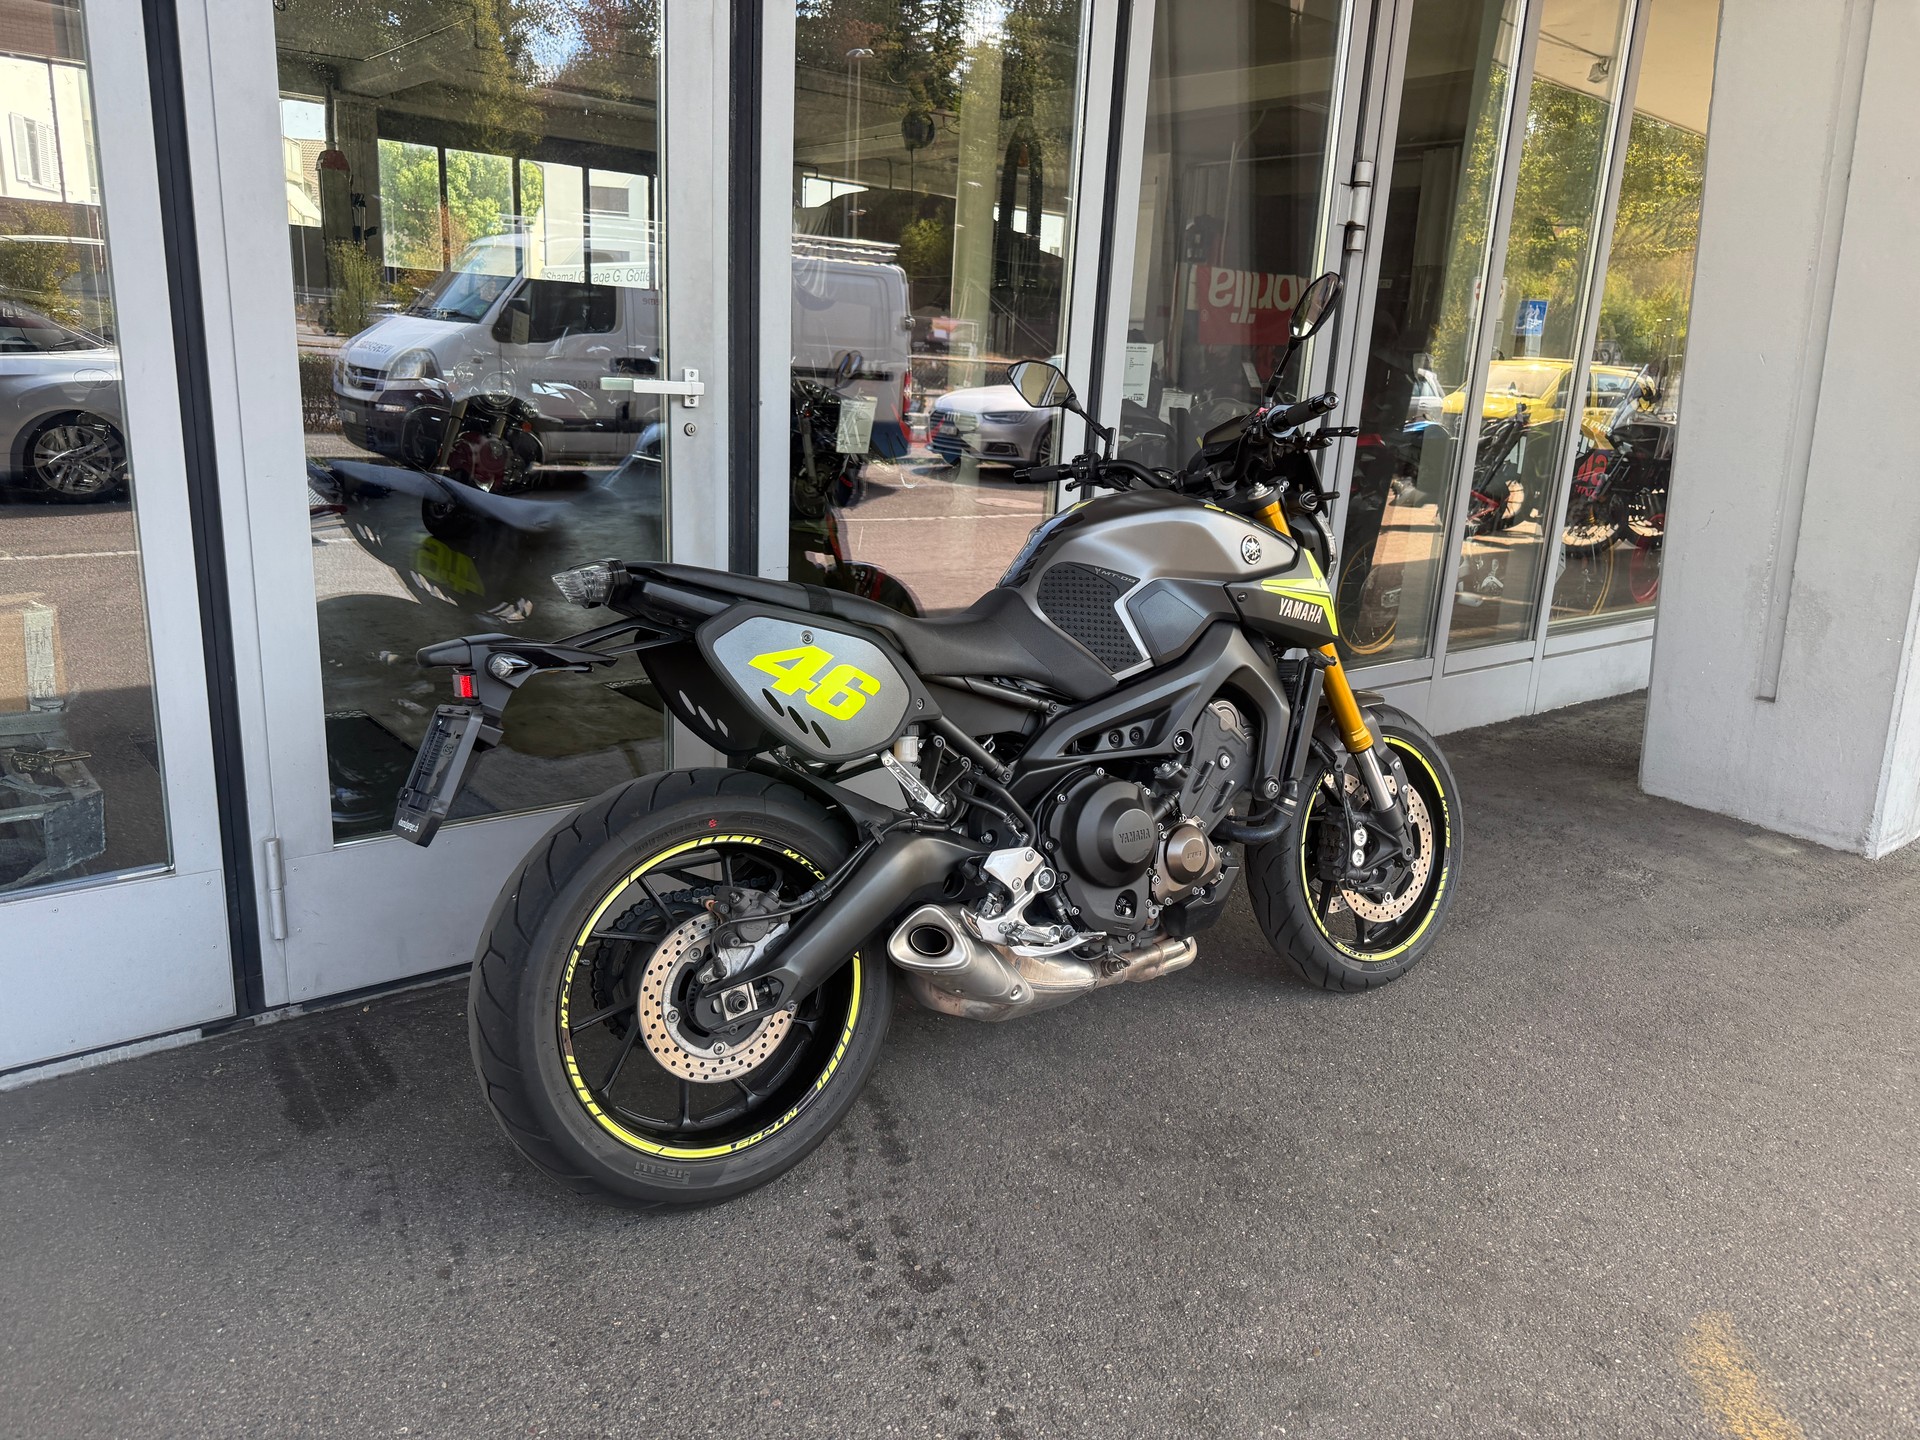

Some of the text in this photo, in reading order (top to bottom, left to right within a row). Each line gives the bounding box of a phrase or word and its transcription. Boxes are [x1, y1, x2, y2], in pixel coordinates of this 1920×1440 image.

[579, 270, 611, 285] Gage
[1100, 568, 1137, 584] MT-09
[1278, 597, 1324, 624] YAMAHA
[747, 645, 881, 721] 46
[1118, 828, 1151, 844] YAMAHA
[782, 848, 826, 881] MT-0
[561, 949, 580, 1029] MT-09
[735, 1107, 799, 1151] MT-09
[635, 1161, 691, 1185] PIRELLI
